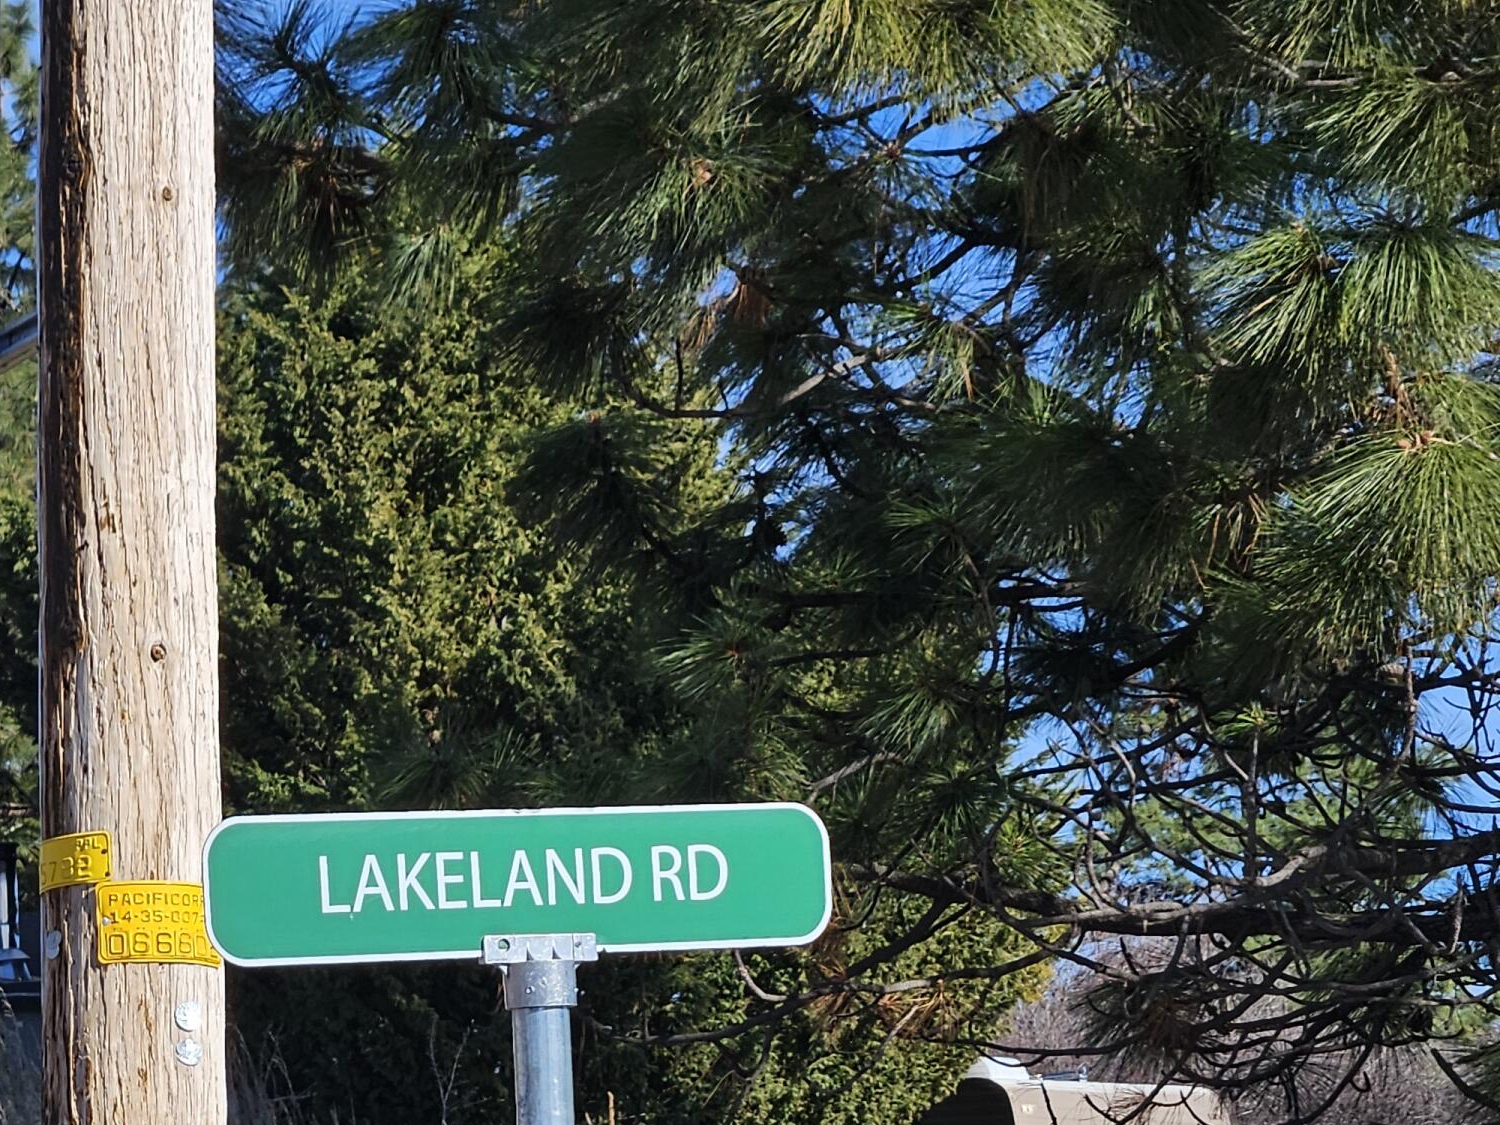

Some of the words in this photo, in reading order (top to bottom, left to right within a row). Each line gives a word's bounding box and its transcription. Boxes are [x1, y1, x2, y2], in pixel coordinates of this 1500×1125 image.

[319, 845, 633, 914] LAKELAND
[651, 844, 728, 904] RD
[108, 931, 219, 958] 06660
